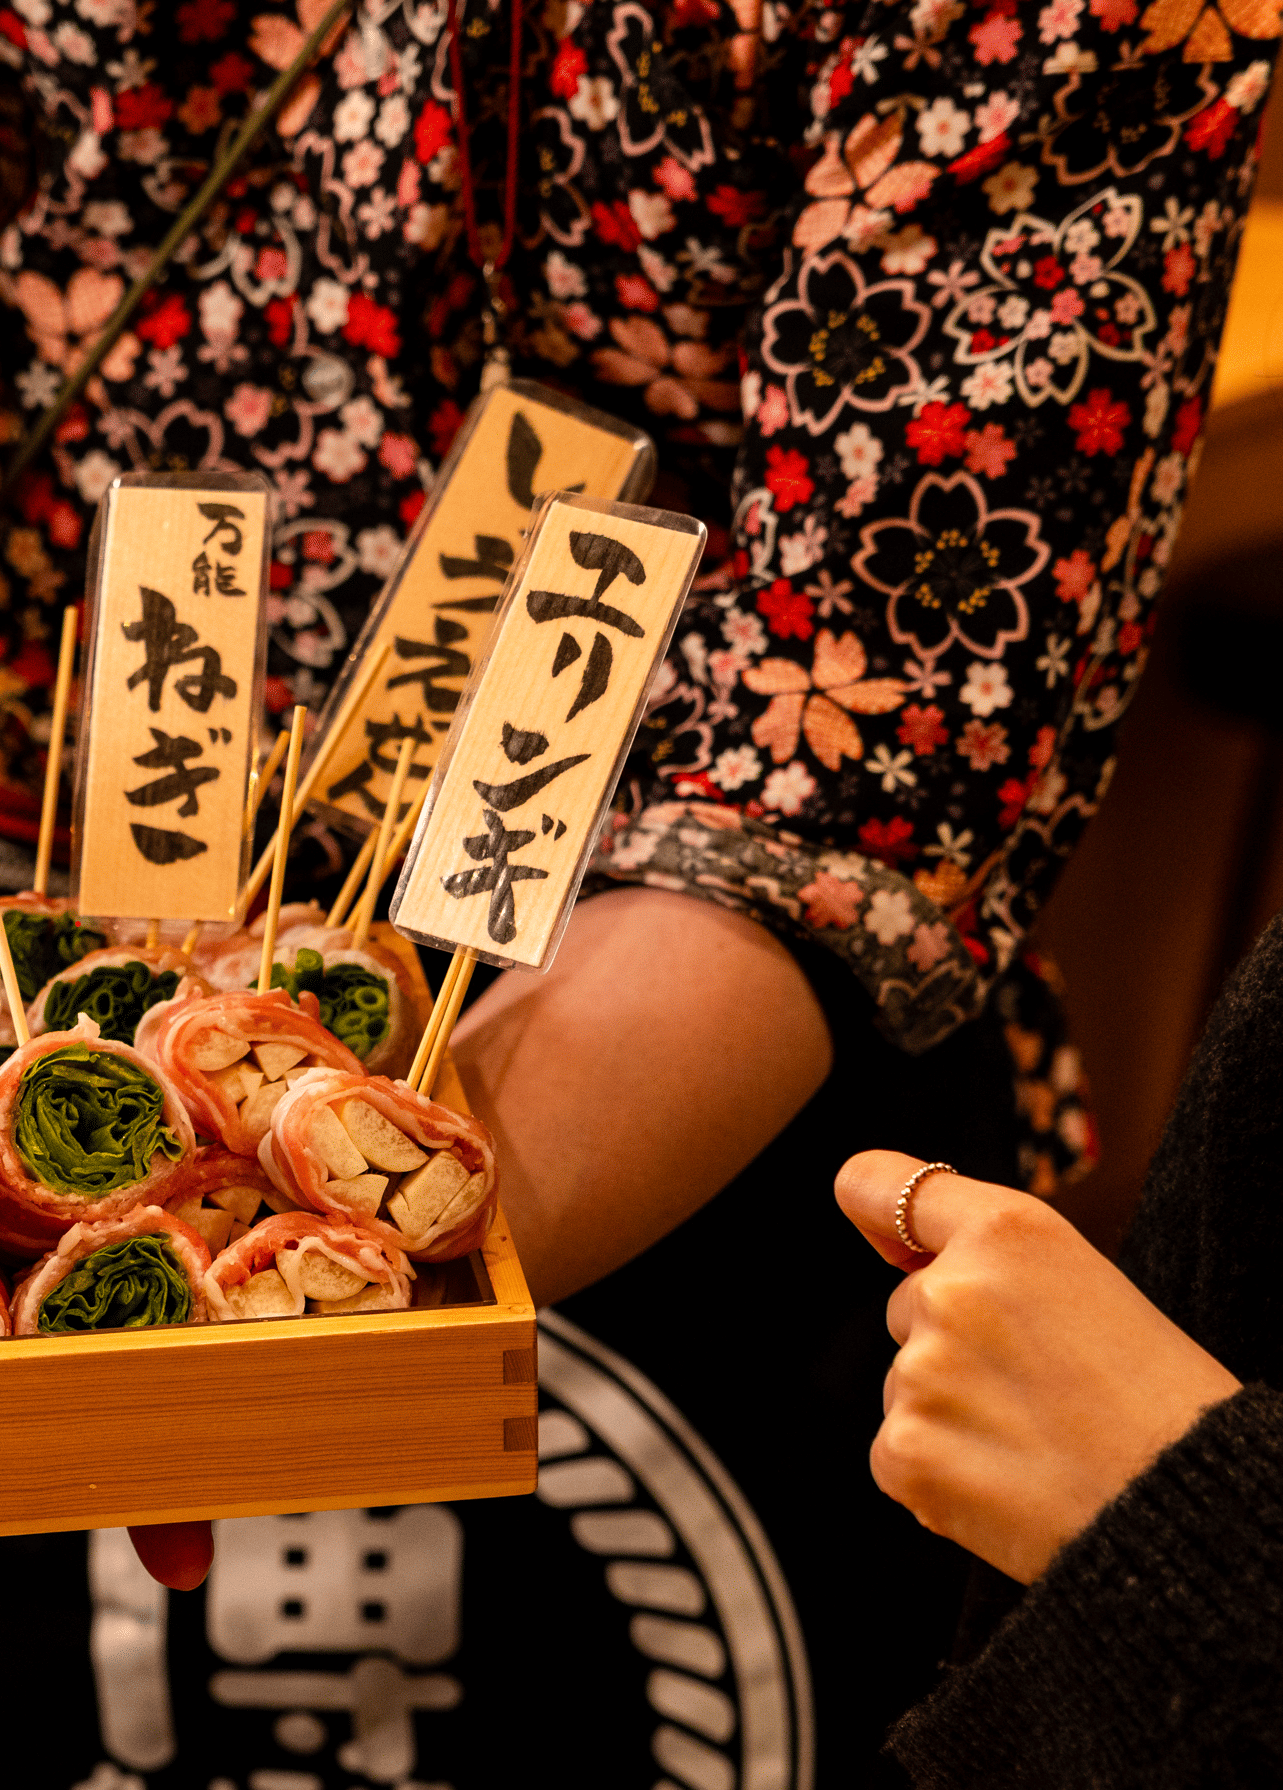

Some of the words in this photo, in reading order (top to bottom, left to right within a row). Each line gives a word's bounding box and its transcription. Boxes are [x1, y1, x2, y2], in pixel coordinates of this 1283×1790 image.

[190, 501, 247, 598] 万能
[440, 530, 646, 944] エリンギ
